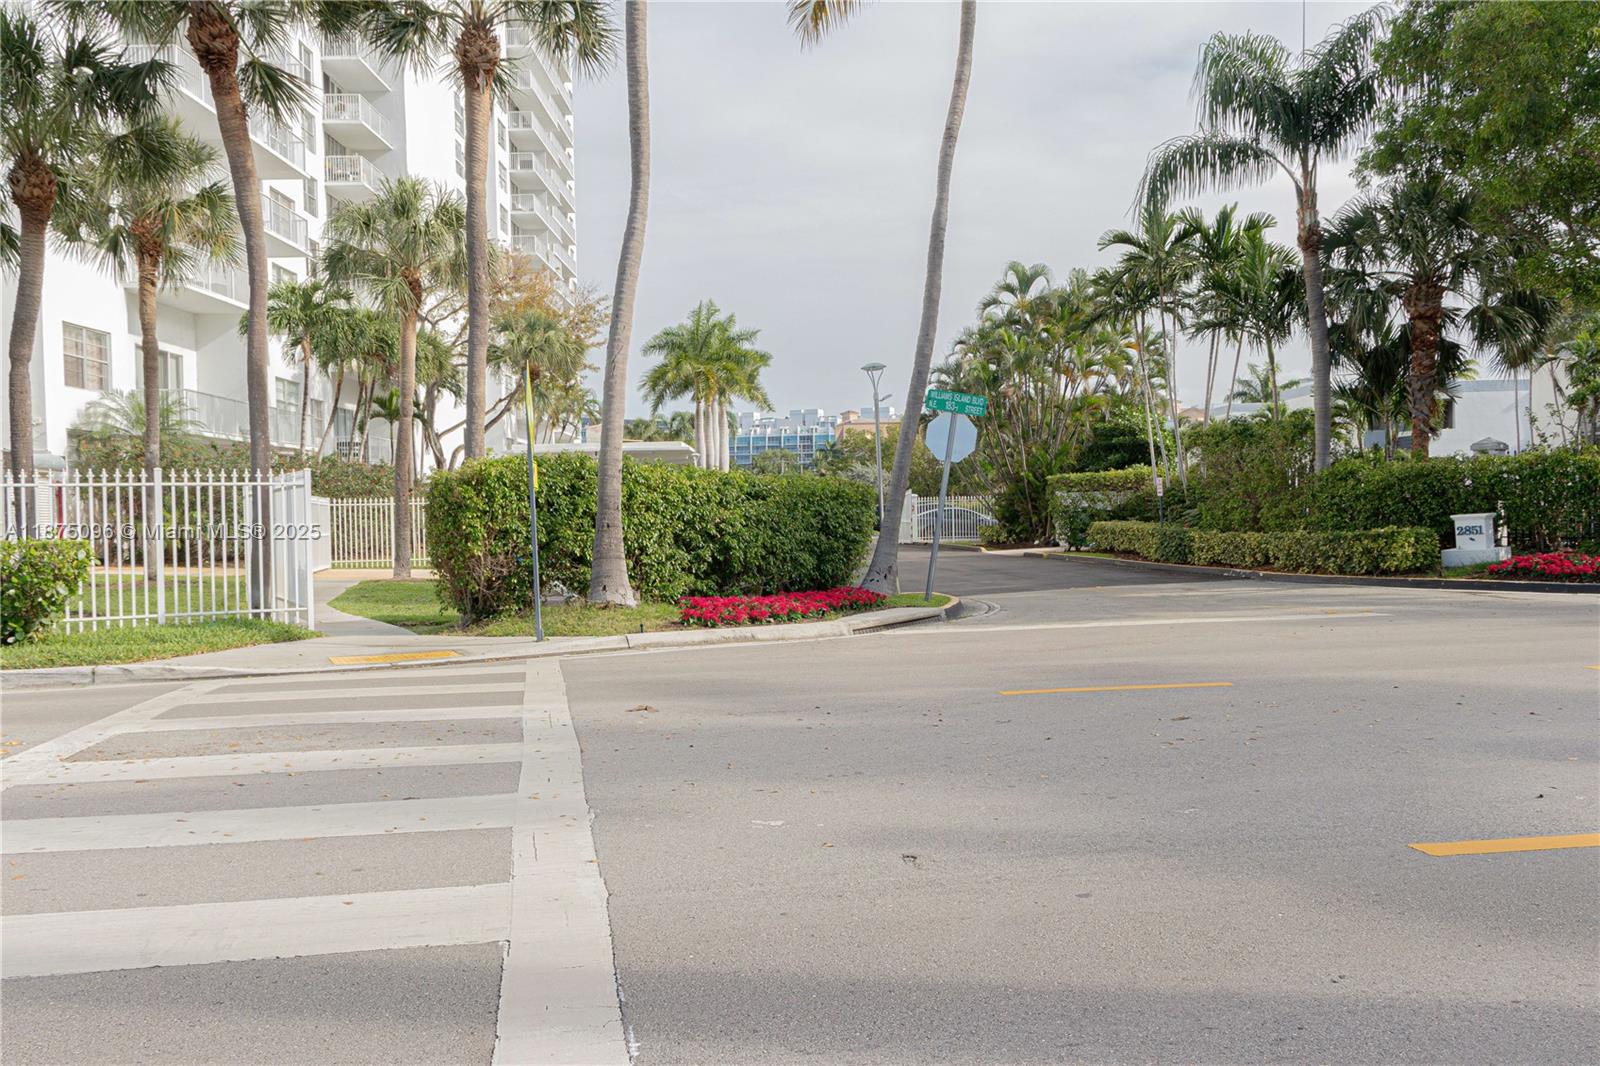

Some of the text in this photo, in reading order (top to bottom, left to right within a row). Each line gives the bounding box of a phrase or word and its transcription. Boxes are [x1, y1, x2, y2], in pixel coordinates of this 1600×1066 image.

[930, 391, 984, 405] WILLIAMS ISLAND BLVD
[965, 405, 983, 414] STREET
[1456, 525, 1484, 536] 2851
